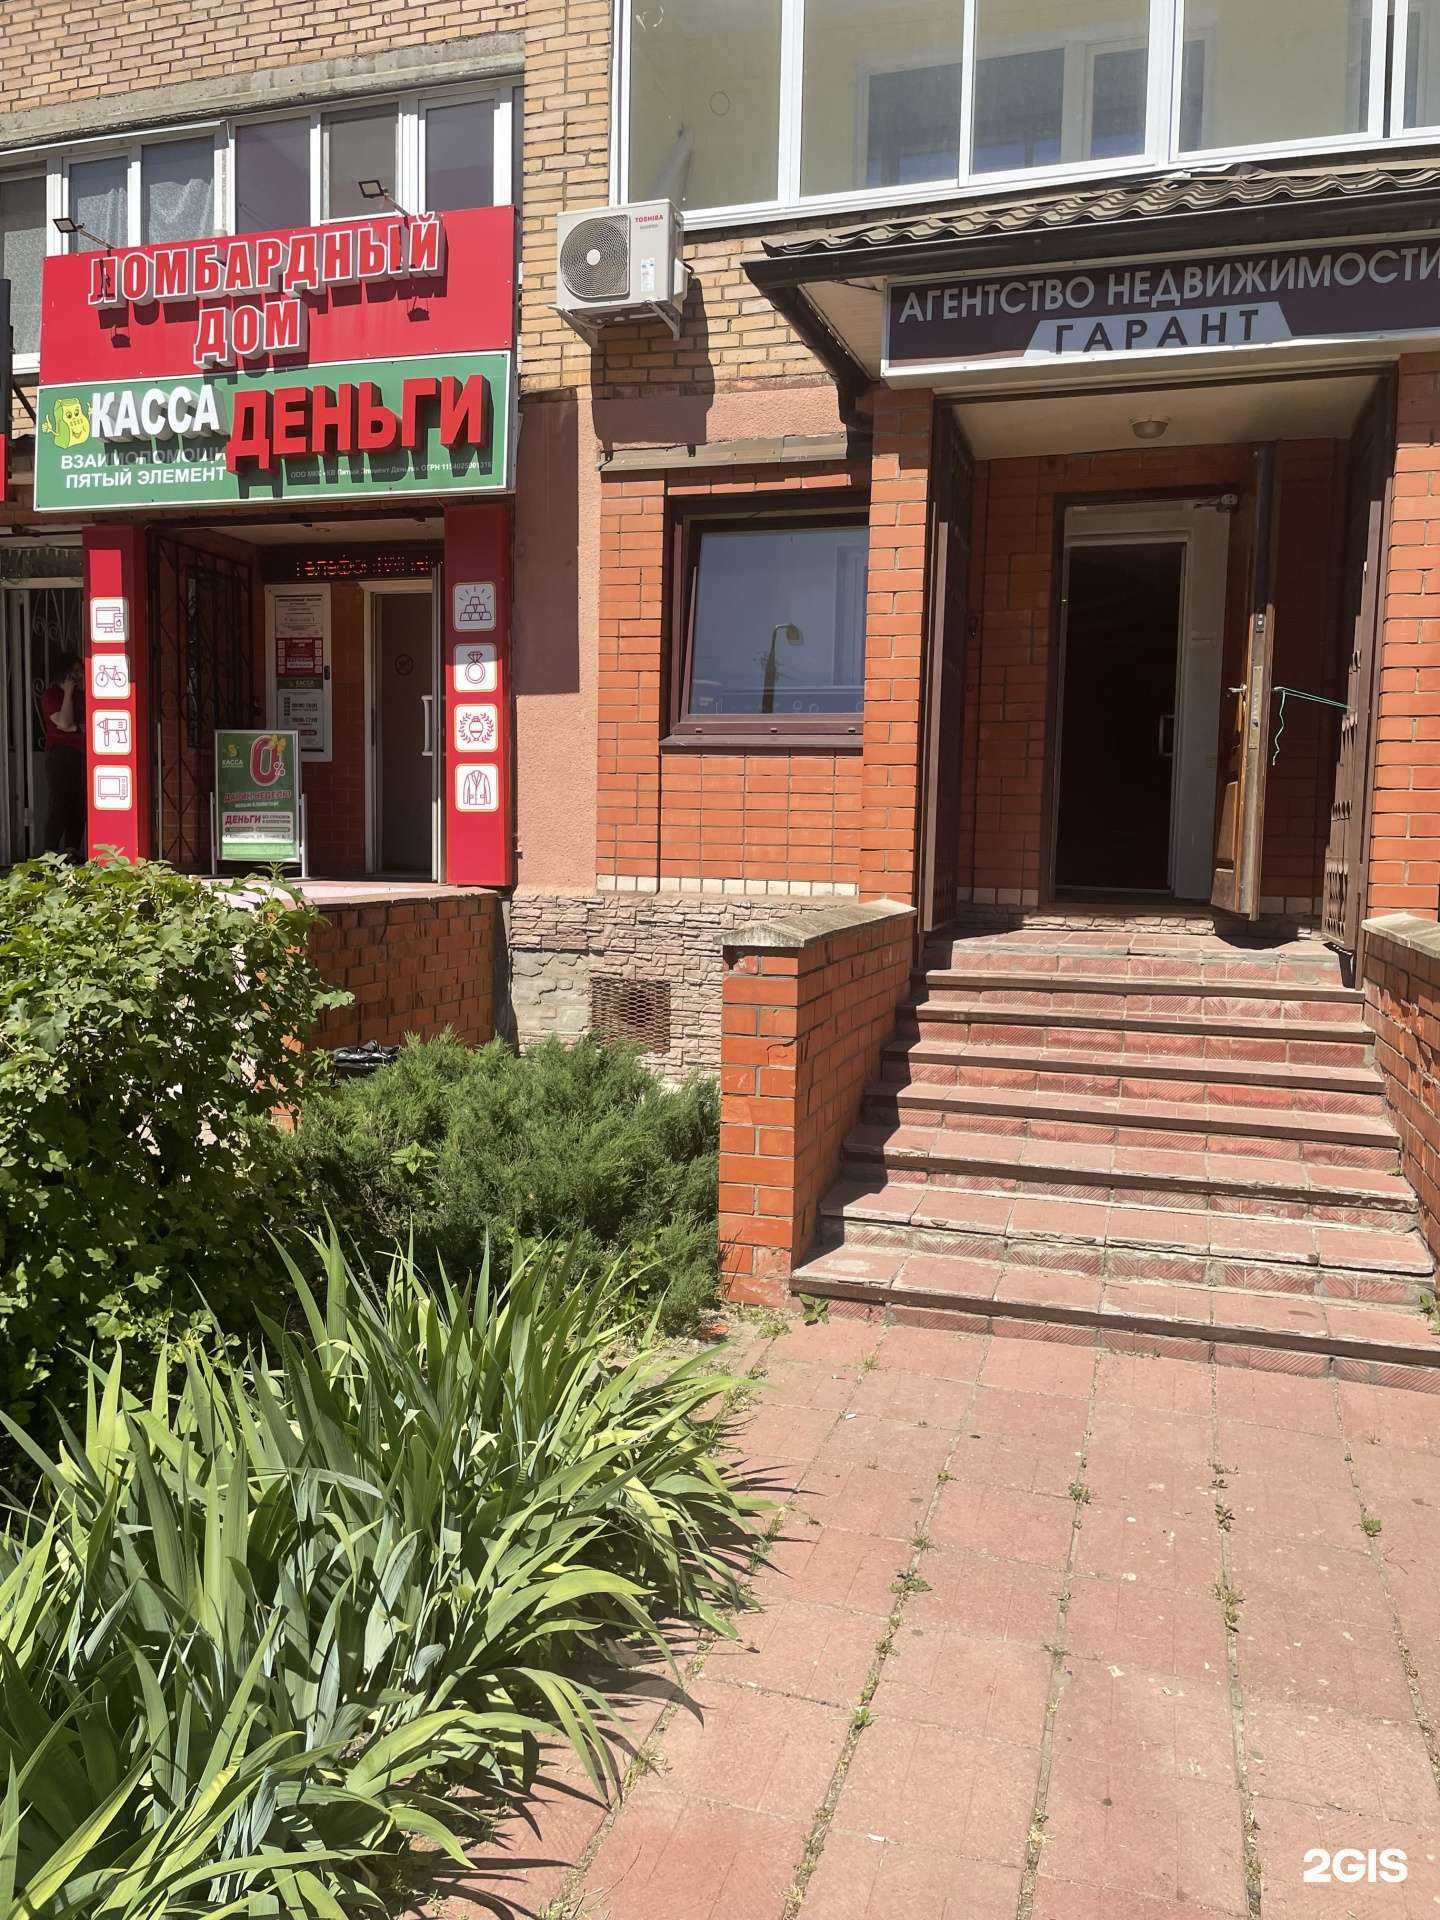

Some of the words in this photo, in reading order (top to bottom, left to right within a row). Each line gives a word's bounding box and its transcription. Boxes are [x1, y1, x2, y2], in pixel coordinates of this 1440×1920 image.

[635, 214, 664, 223] TOSHIBA
[88, 211, 440, 305] ЛОМБАРДНЫЙ
[898, 274, 1096, 324] АГЕНТСТВО
[1107, 246, 1440, 307] НЕДВИЖИМОСТИ
[193, 299, 302, 365] ДОМ
[1054, 308, 1260, 356] ГАРАНТ
[91, 384, 220, 439] КАССА
[226, 374, 486, 475] ДЕНЬГИ
[61, 447, 227, 470] ВЗАИМОПОМОЩИ
[66, 467, 132, 489] ПЯТЫЙ
[137, 466, 227, 485] ЭЛЕМЕНТ
[225, 814, 261, 826] ДЕНЬГИ
